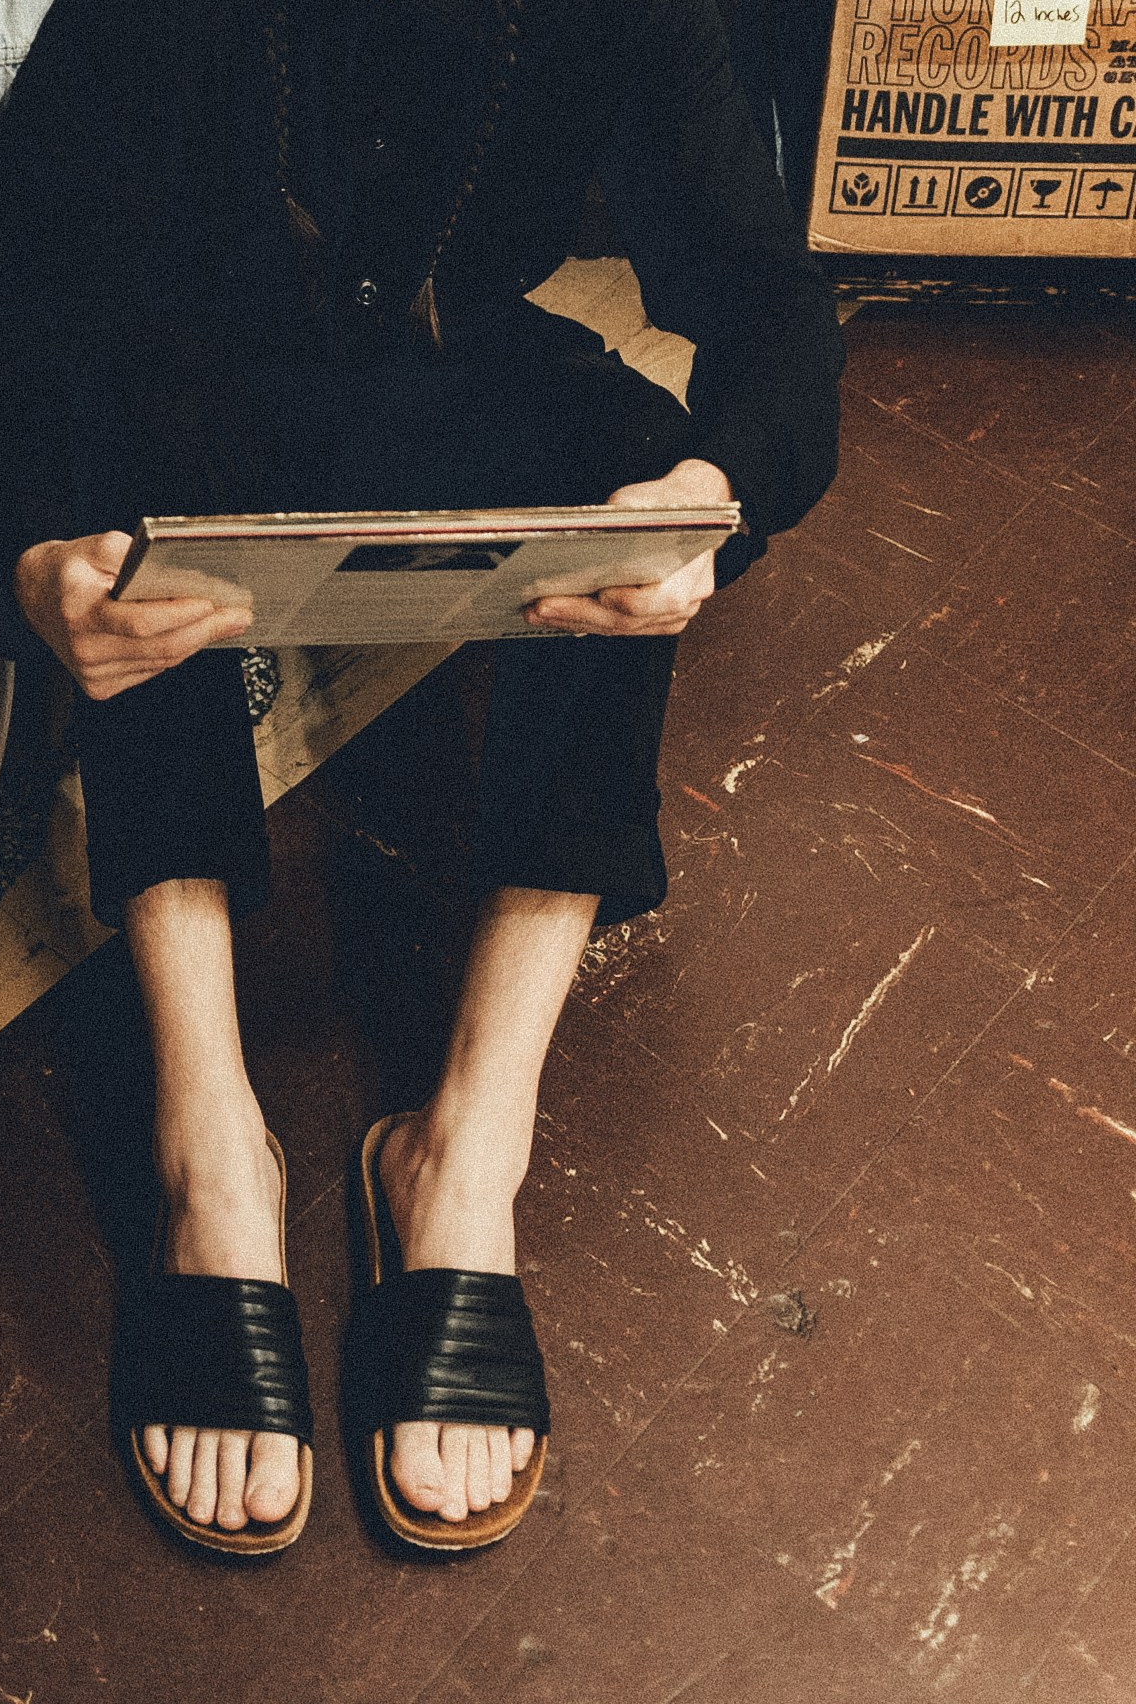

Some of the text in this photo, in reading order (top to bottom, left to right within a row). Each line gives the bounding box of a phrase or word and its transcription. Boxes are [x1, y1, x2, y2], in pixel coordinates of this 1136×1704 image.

[1004, 0, 1026, 24] 12
[846, 21, 1102, 92] RECORDS
[840, 88, 994, 136] HANDLE
[1004, 94, 1099, 139] WITH
